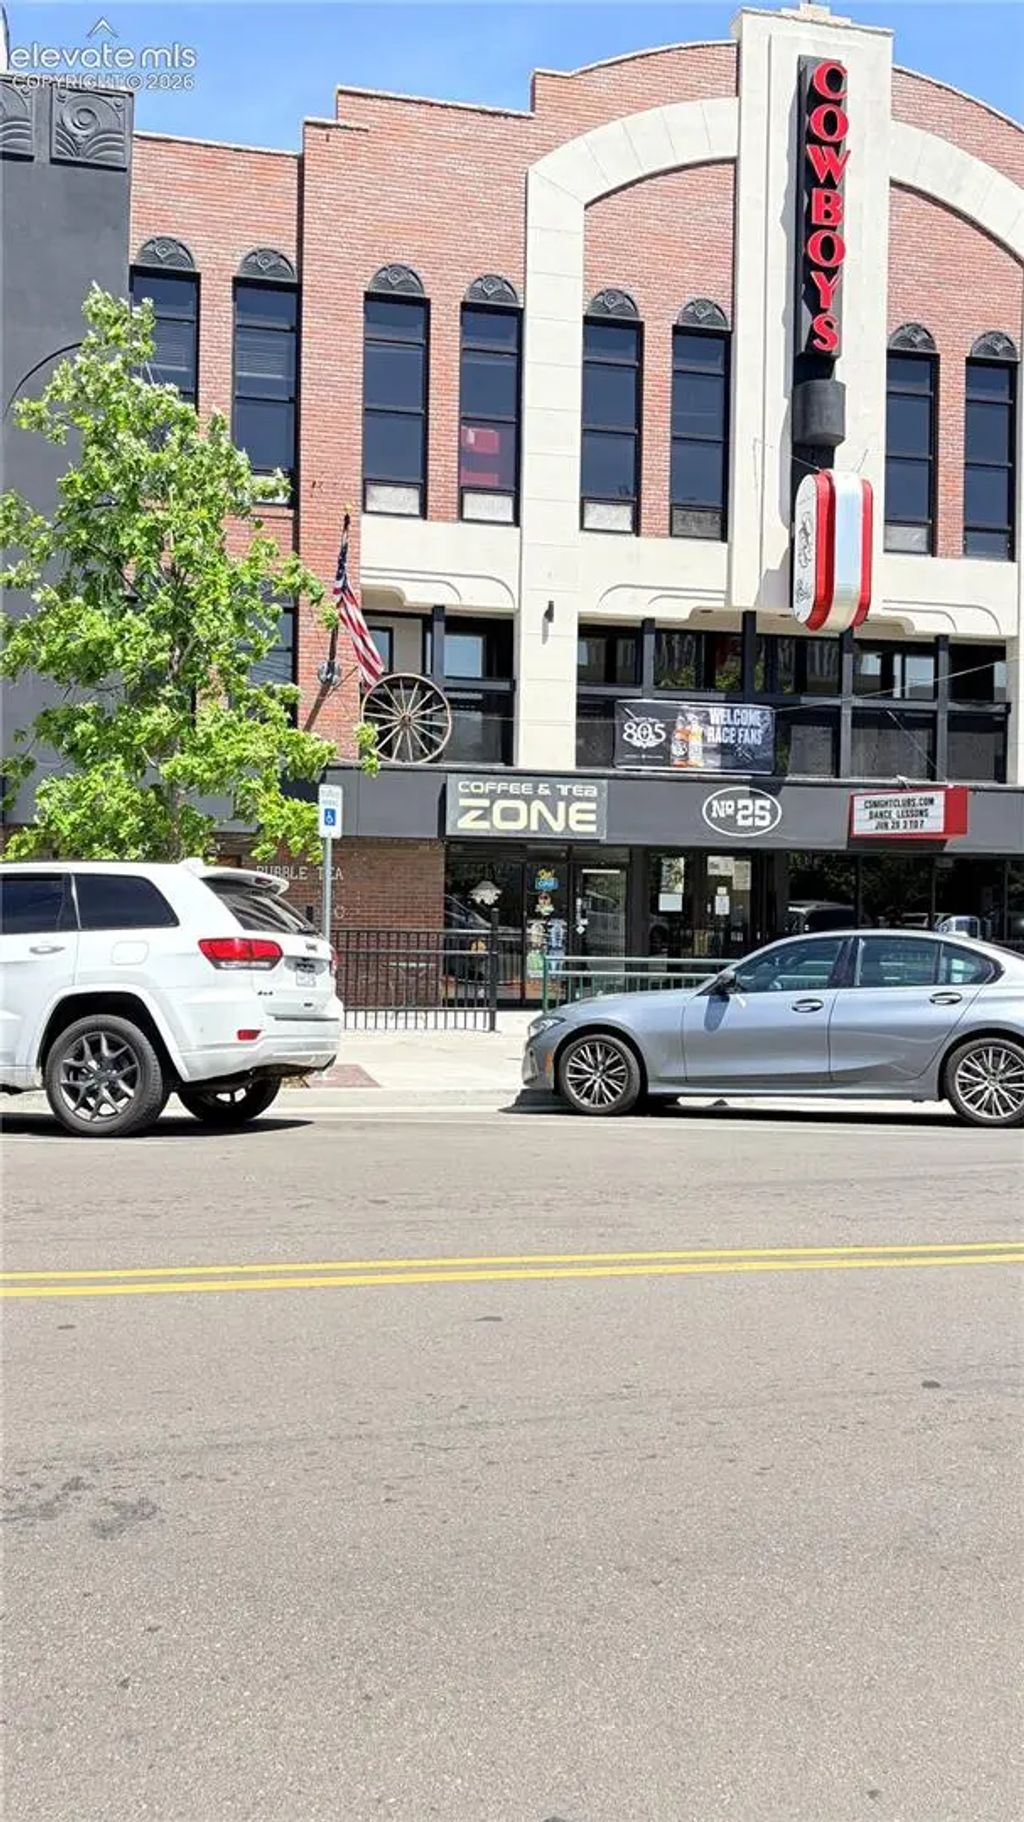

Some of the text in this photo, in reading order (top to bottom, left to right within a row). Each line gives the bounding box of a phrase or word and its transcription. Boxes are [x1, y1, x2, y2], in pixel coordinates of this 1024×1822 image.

[806, 62, 851, 351] COWBOYS
[709, 706, 762, 726] WELCOME
[622, 721, 666, 742] 805
[707, 727, 762, 745] RACE FANS
[458, 781, 598, 798] COFFEE & TEA
[457, 798, 598, 833] ZONE
[736, 799, 771, 827] 25
[869, 808, 929, 819] DANCE LESSONS
